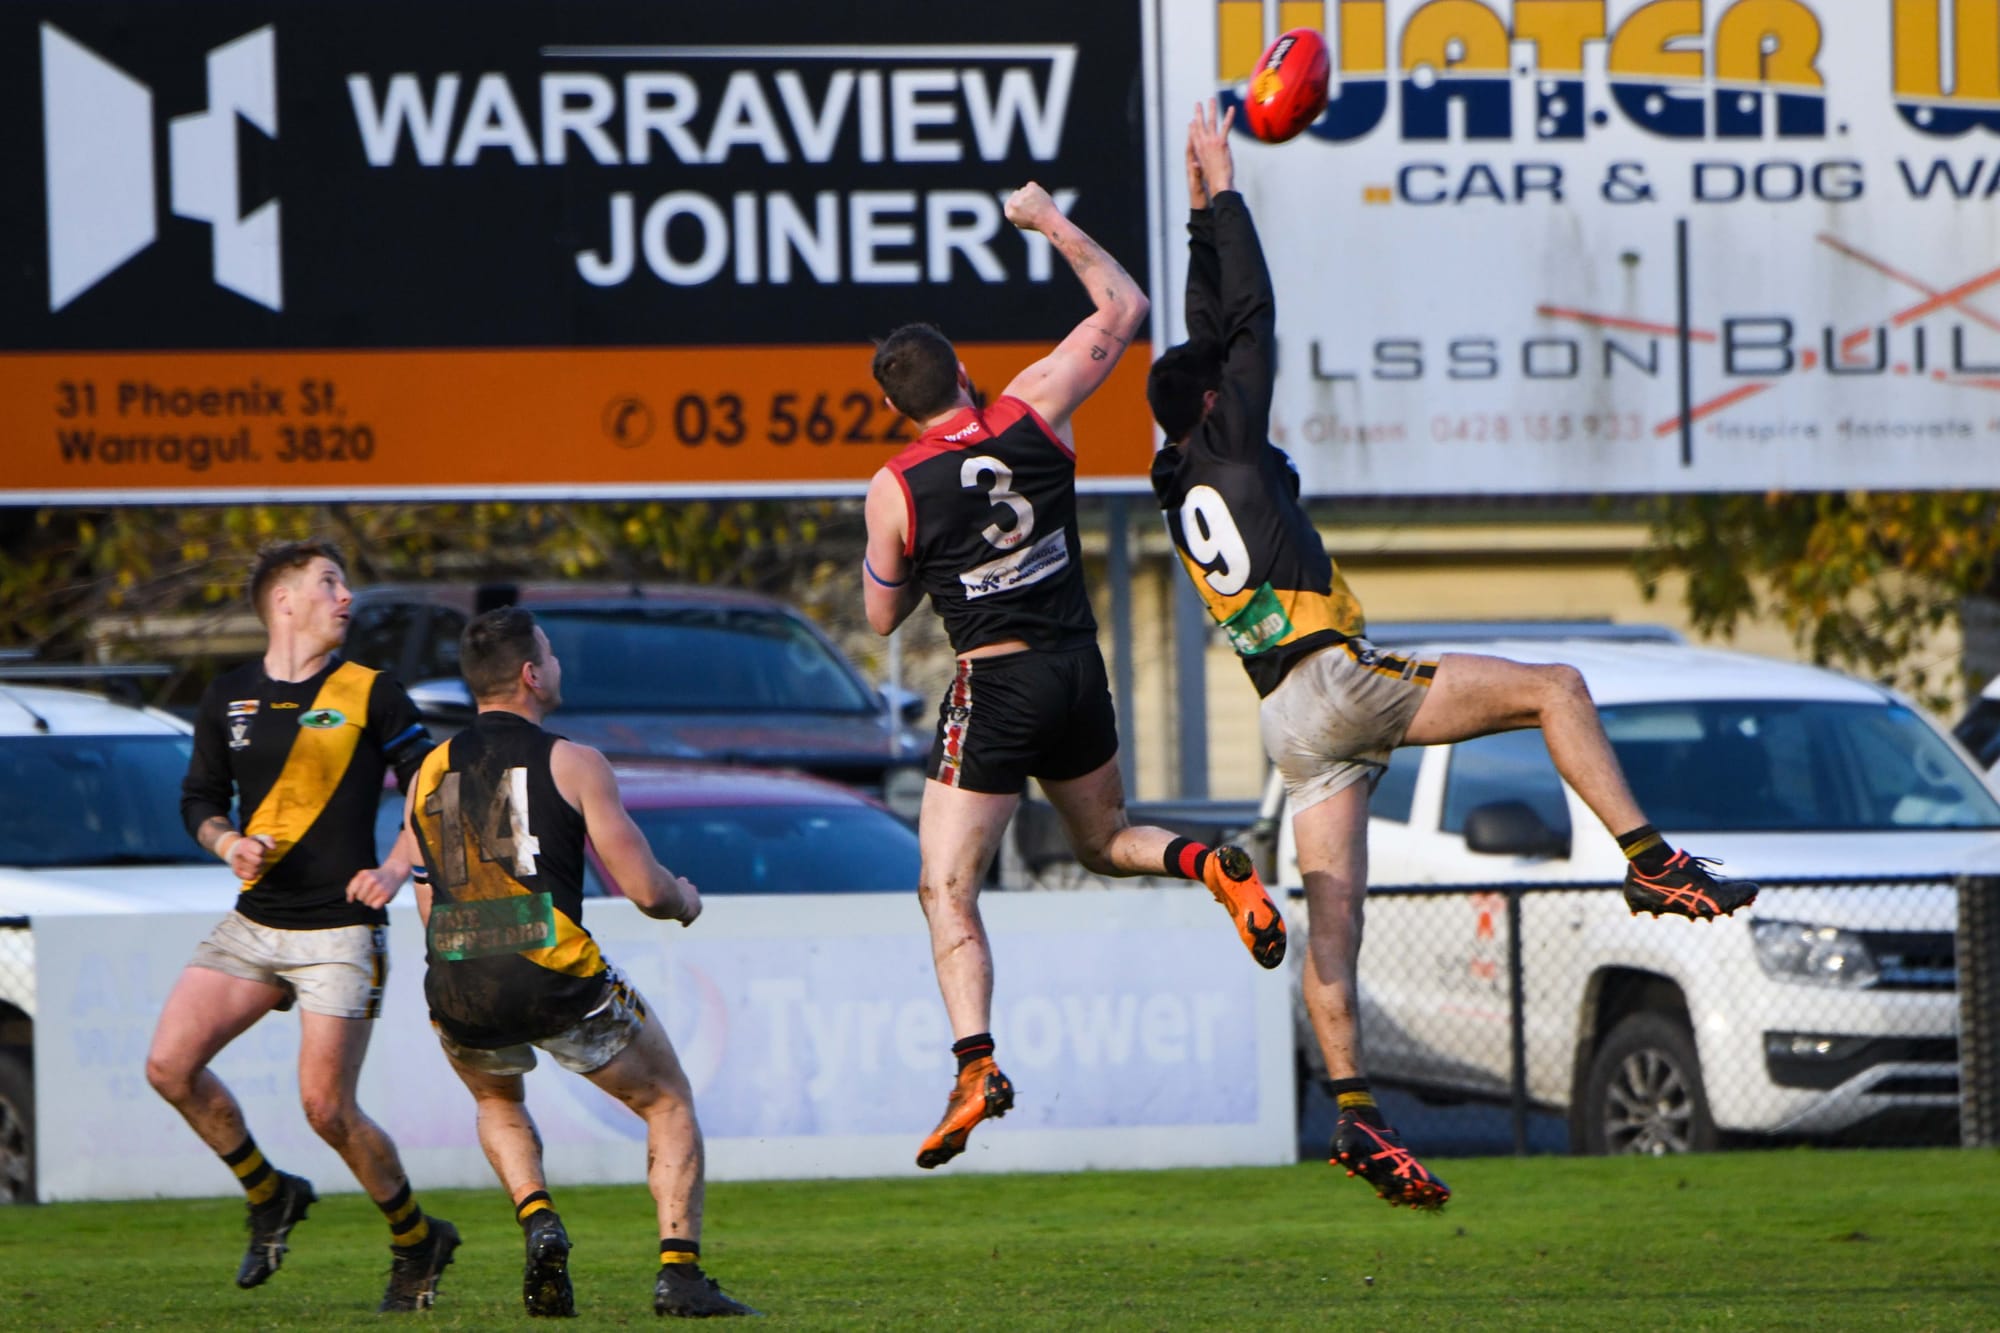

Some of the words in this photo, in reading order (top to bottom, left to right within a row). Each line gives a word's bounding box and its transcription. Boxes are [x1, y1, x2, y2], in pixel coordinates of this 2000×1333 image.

[347, 68, 1077, 167] WARRAVIEW
[1396, 161, 1565, 203] CAR
[1601, 161, 1653, 202] &
[1694, 161, 1864, 201] DOG
[1274, 337, 1660, 382] LSSON
[56, 382, 98, 419] 31
[117, 379, 286, 418] Phoenix
[673, 393, 748, 446] 03
[275, 424, 376, 464] 3820
[944, 421, 980, 442] WFNC
[960, 455, 1035, 550] 3
[1180, 484, 1252, 596] 9
[426, 767, 541, 886] 14
[749, 976, 1233, 1098] Tyreower
